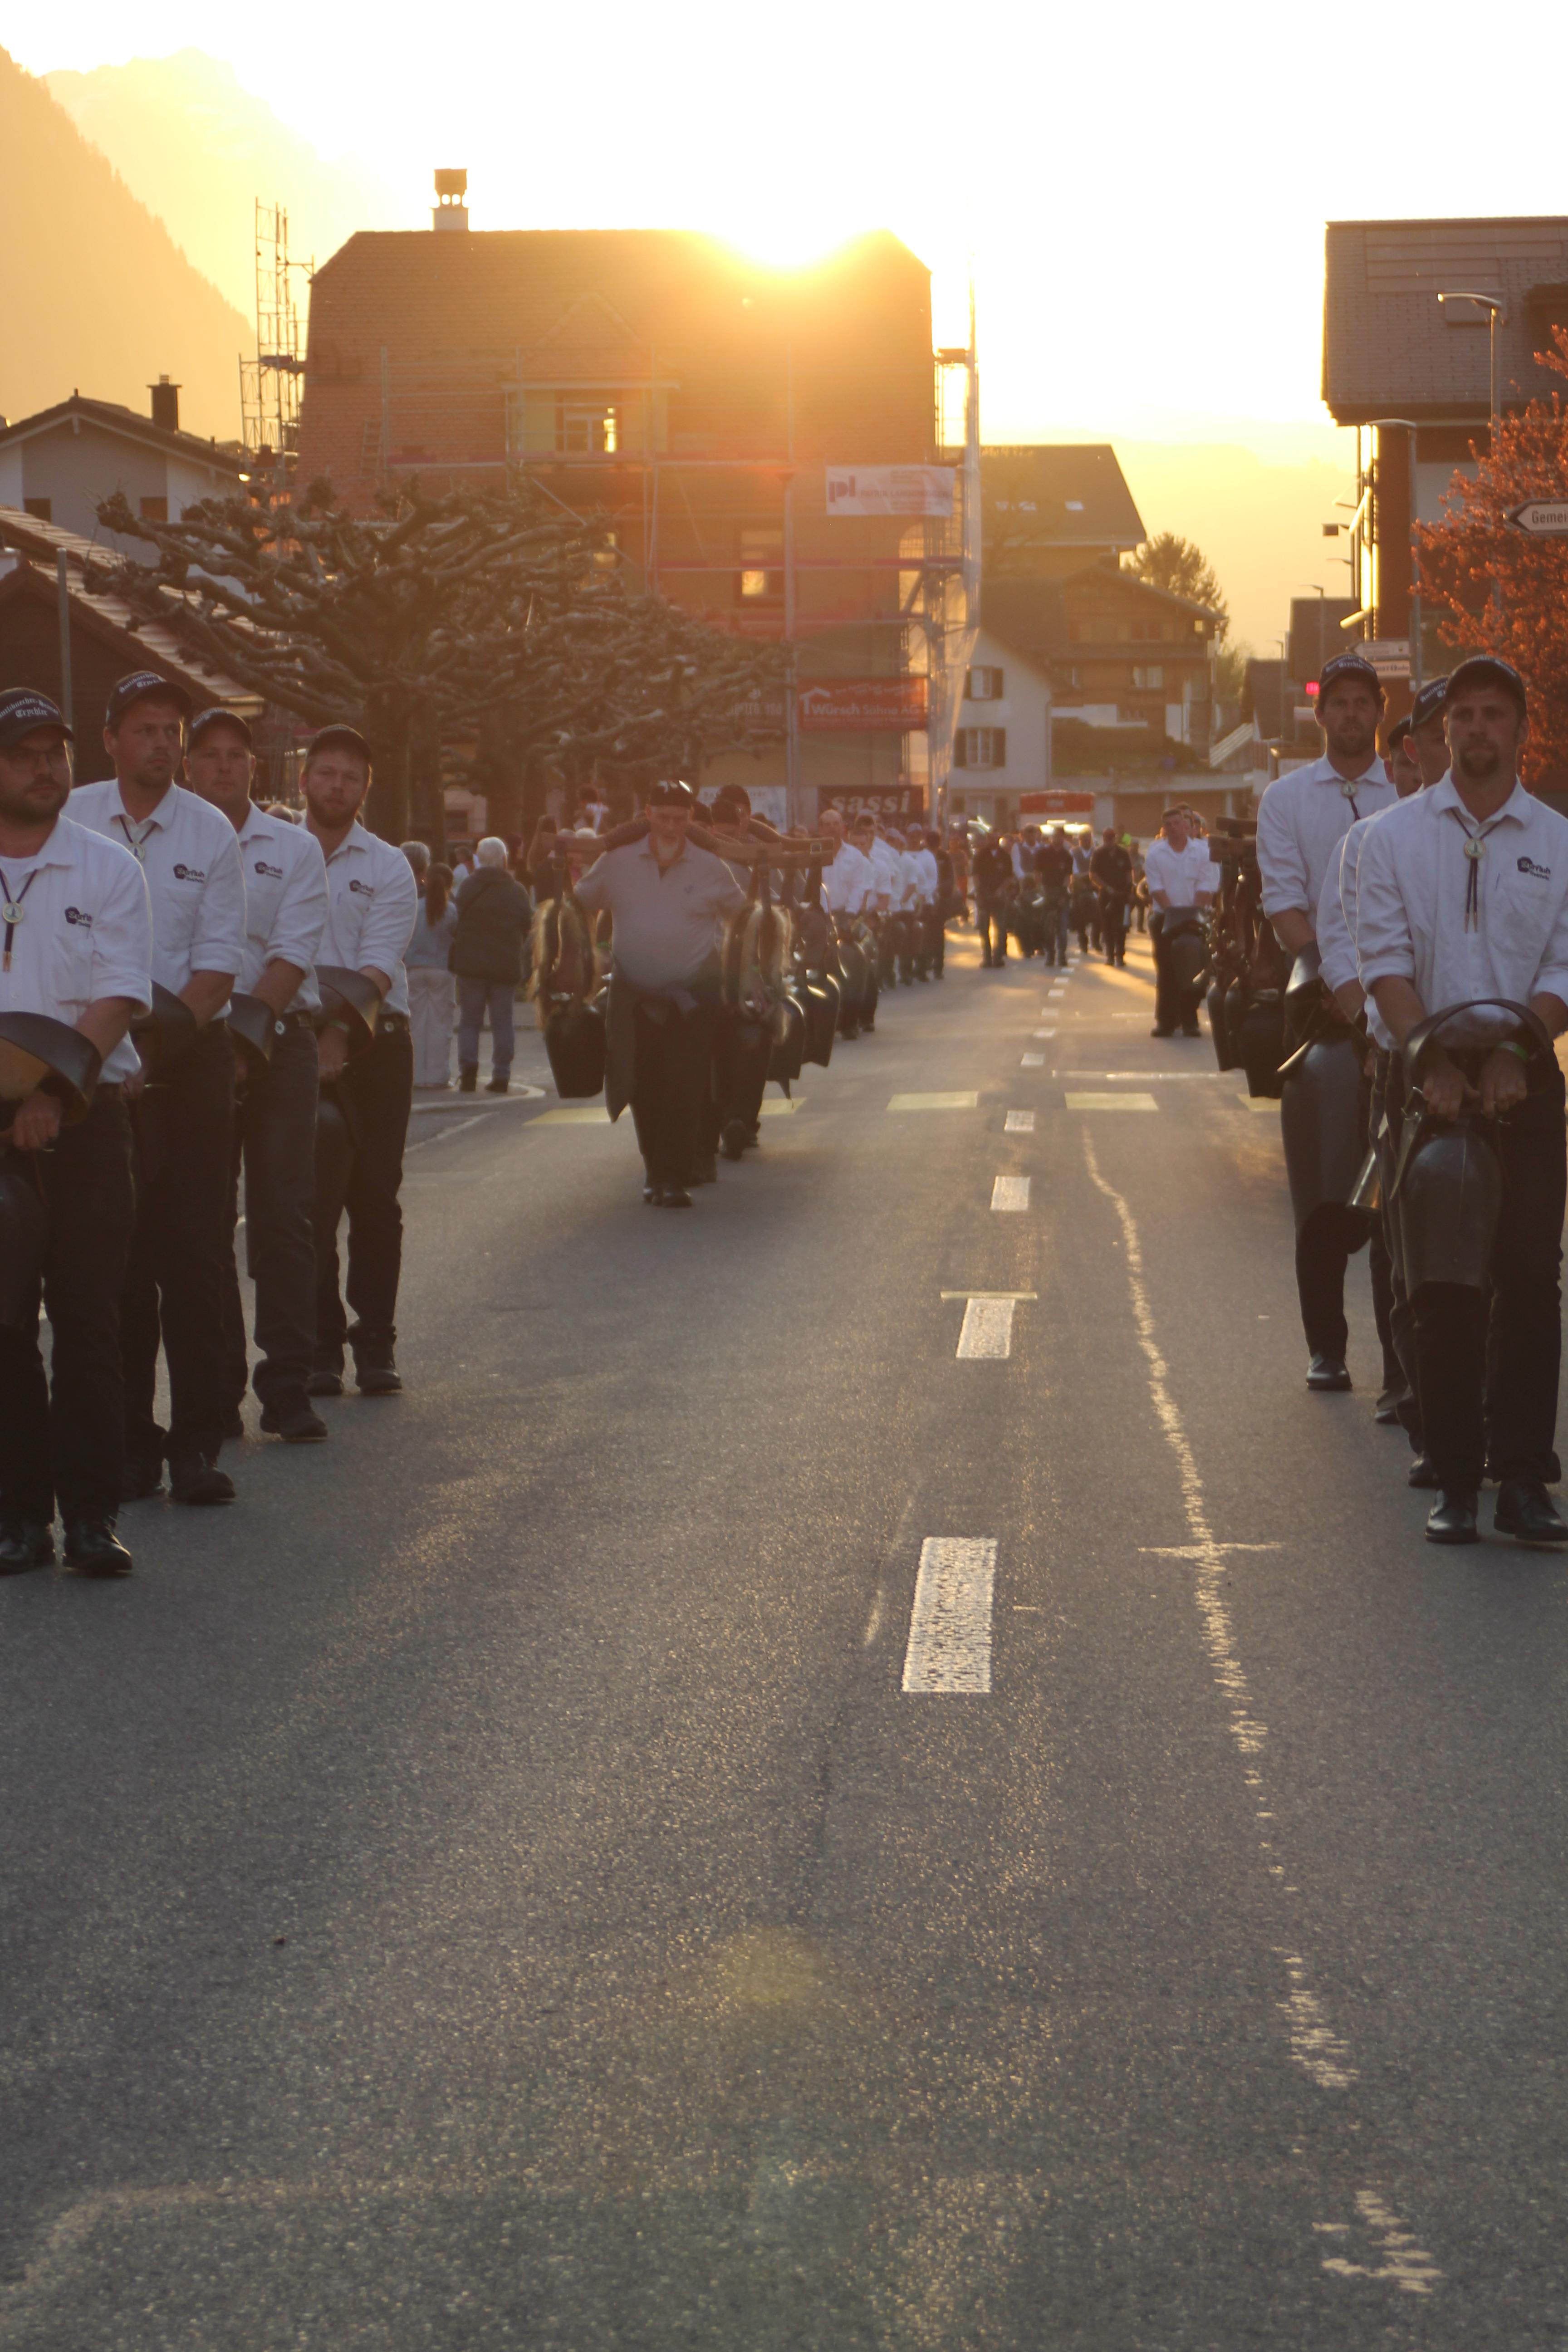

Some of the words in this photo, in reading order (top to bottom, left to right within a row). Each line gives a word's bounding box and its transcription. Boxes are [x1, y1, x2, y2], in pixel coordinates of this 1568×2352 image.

[1532, 510, 1568, 524] Gemei
[811, 702, 860, 715] Würsch
[901, 704, 919, 715] AG
[831, 791, 910, 813] sassi
